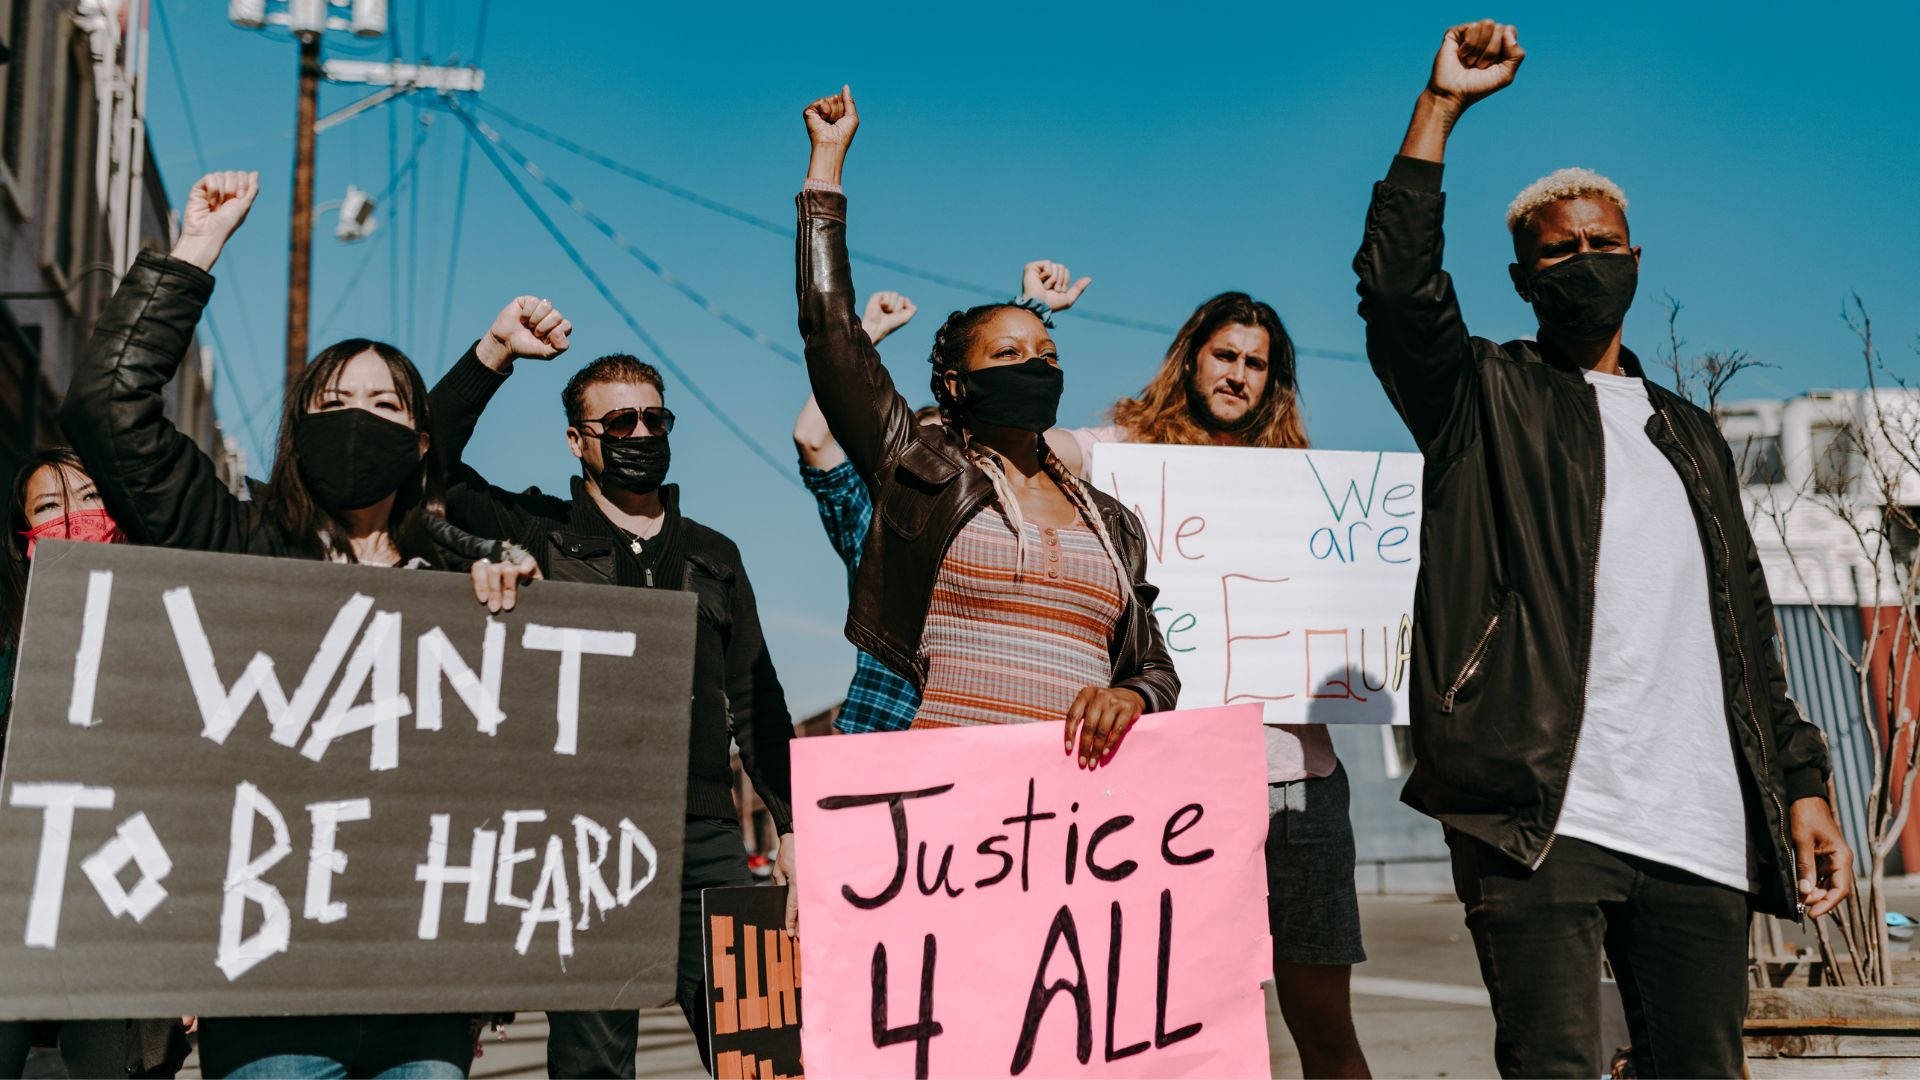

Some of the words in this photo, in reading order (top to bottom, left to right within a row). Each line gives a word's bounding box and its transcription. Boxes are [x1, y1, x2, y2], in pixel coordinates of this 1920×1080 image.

[1305, 450, 1416, 522] We
[1309, 521, 1412, 564] are
[68, 570, 113, 727] I
[162, 585, 637, 771] WANT
[1221, 573, 1412, 705] EQUA
[10, 782, 172, 950] TO
[215, 781, 371, 982] BE
[414, 809, 658, 963] HEARD
[816, 777, 1214, 910] Justice
[871, 932, 944, 1080] 4
[1009, 889, 1203, 1076] ALL
